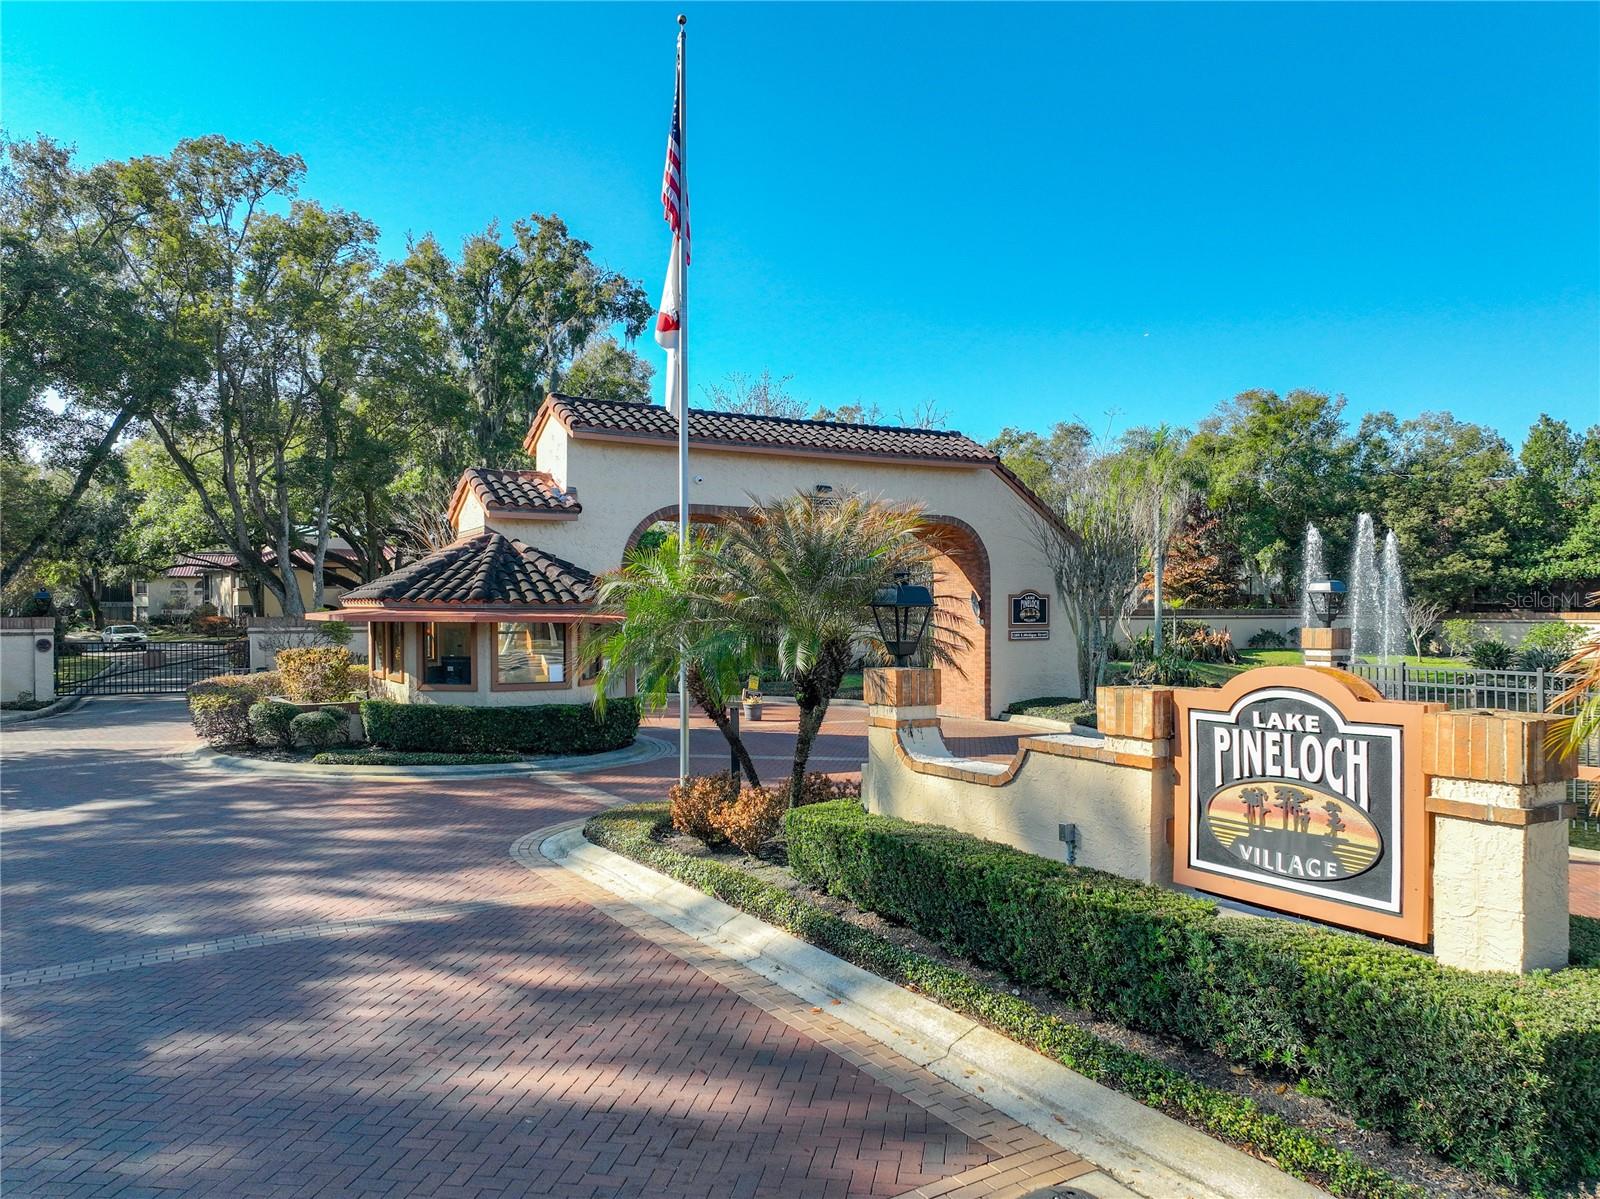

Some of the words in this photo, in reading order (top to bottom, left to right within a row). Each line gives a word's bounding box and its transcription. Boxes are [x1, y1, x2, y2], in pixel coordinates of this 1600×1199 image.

[1252, 711, 1320, 732] LAKE
[1213, 727, 1370, 813] PINELOCH
[1238, 844, 1337, 878] VILLAGE
